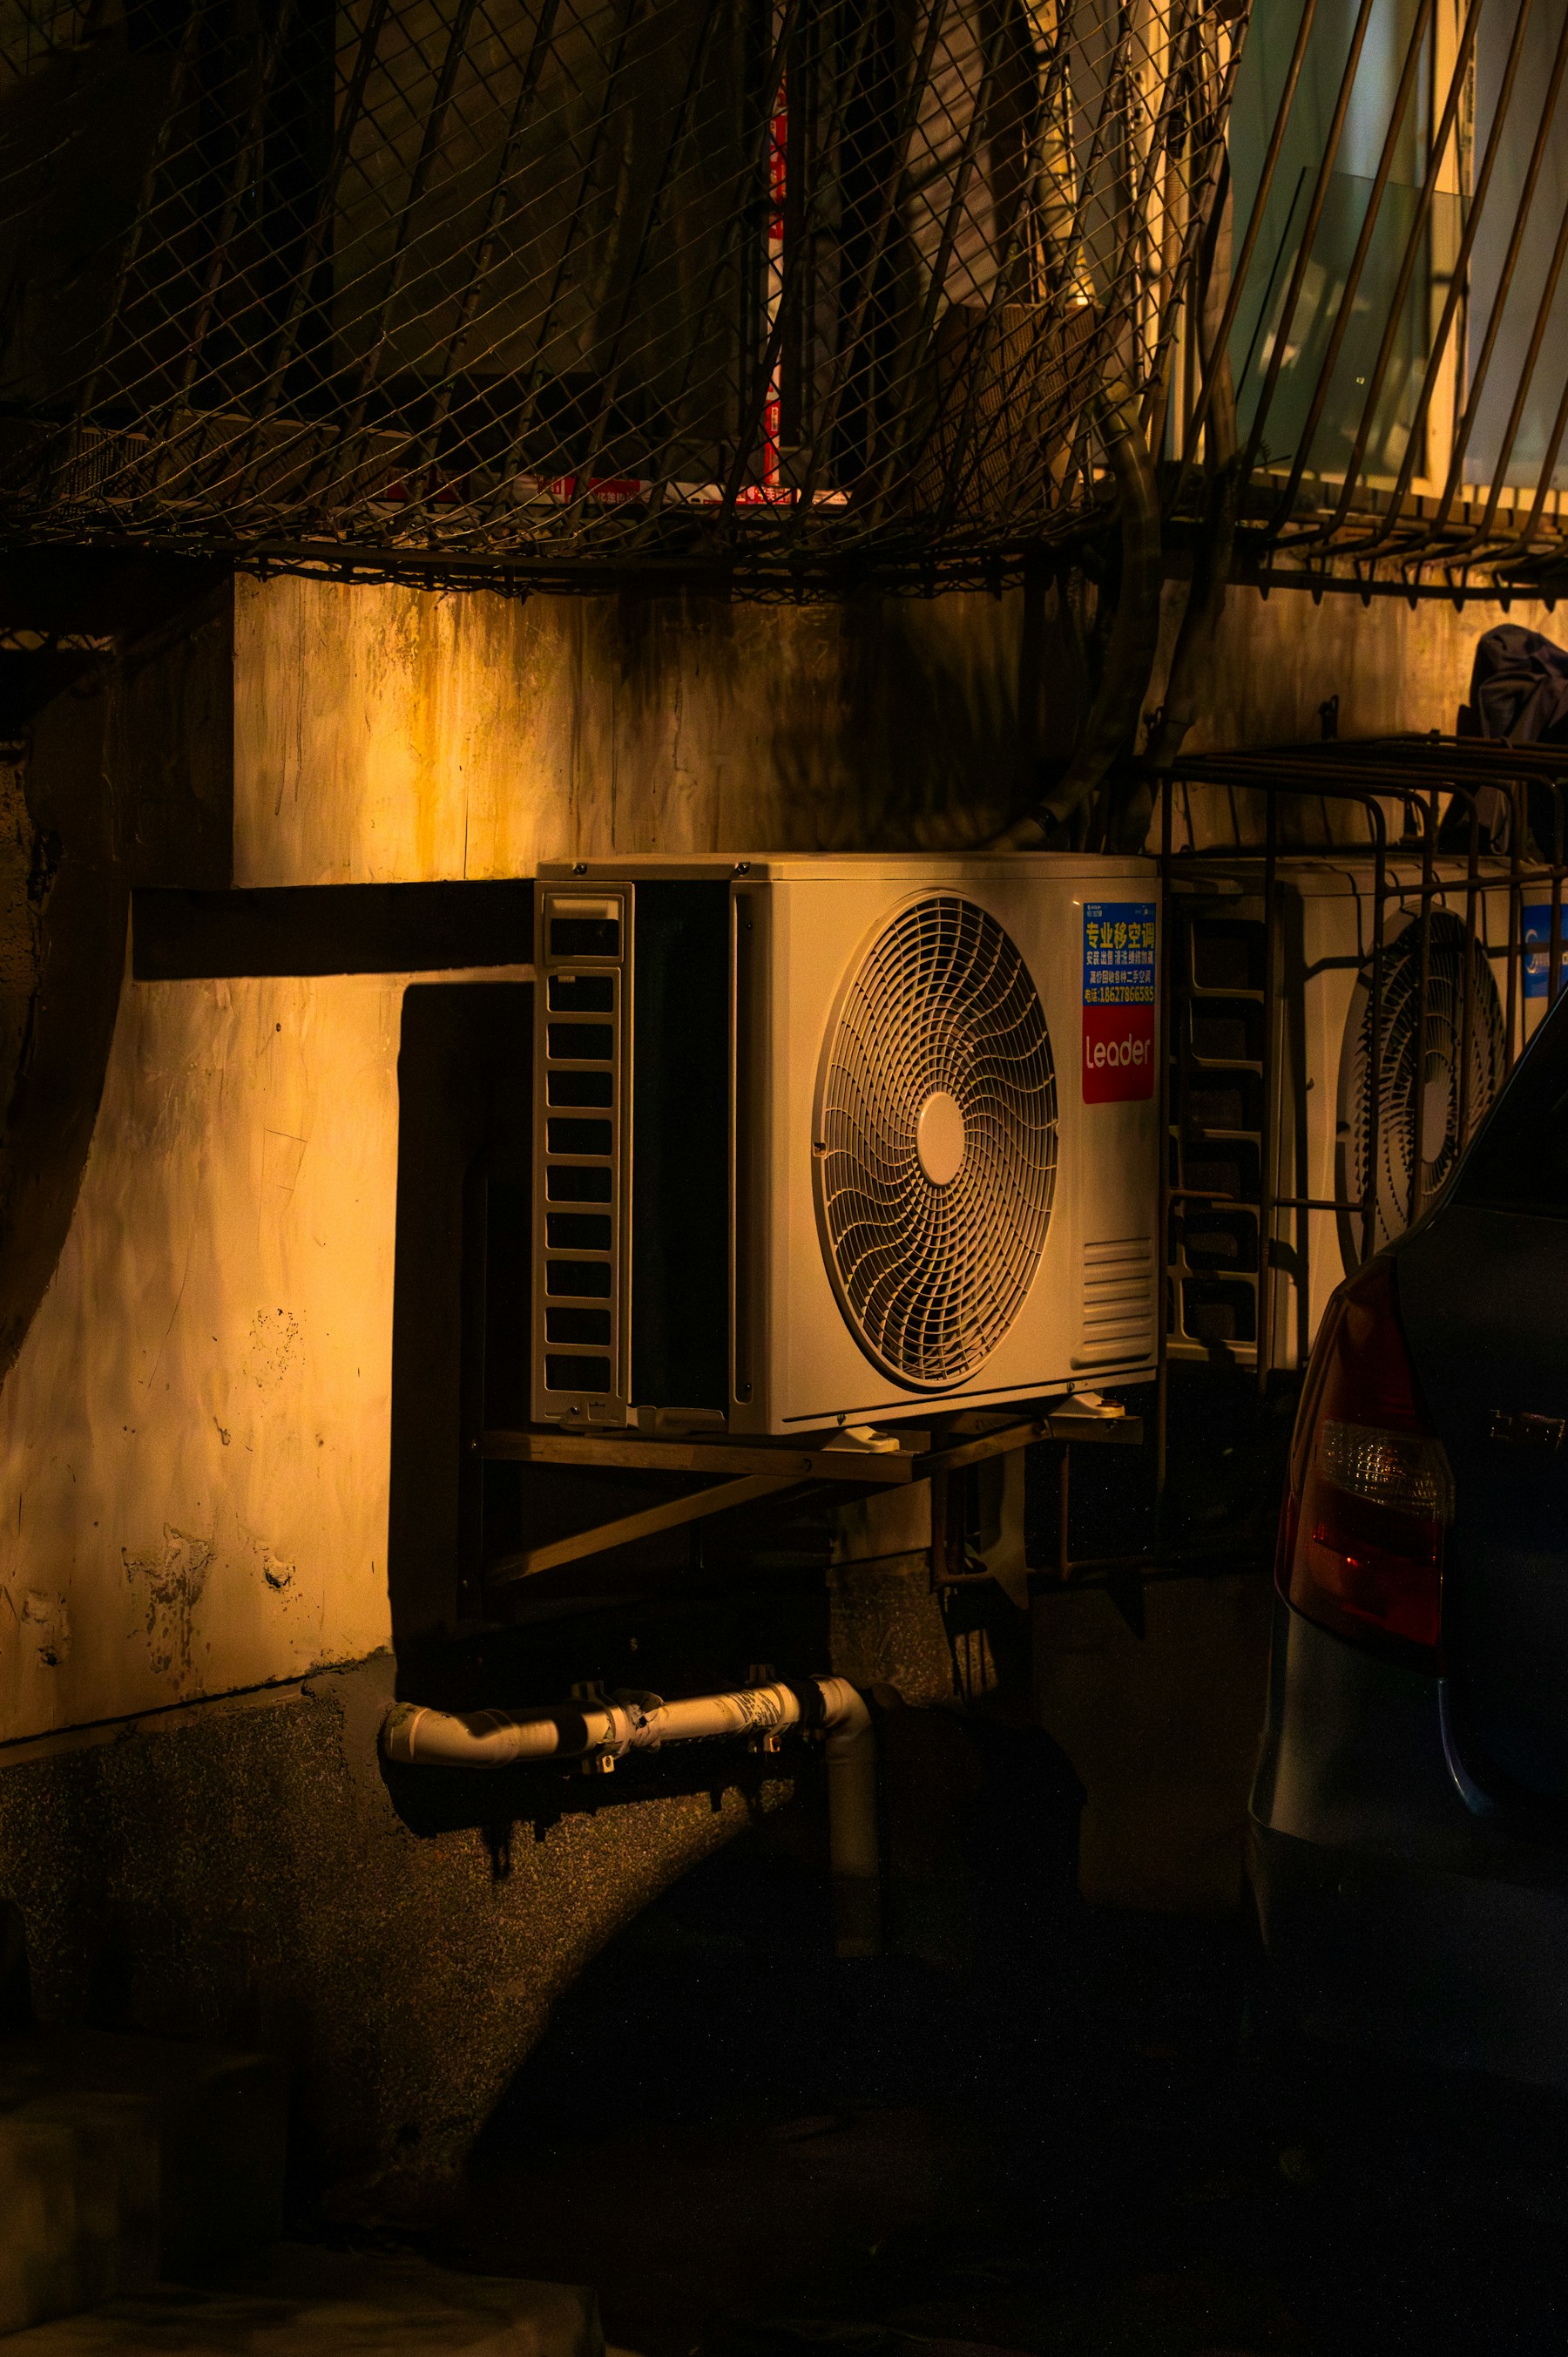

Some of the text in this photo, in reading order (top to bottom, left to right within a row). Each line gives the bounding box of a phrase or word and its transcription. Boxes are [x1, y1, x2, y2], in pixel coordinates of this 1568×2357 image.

[1086, 922, 1154, 949] 专业移空调
[1086, 1033, 1151, 1068] Leader
